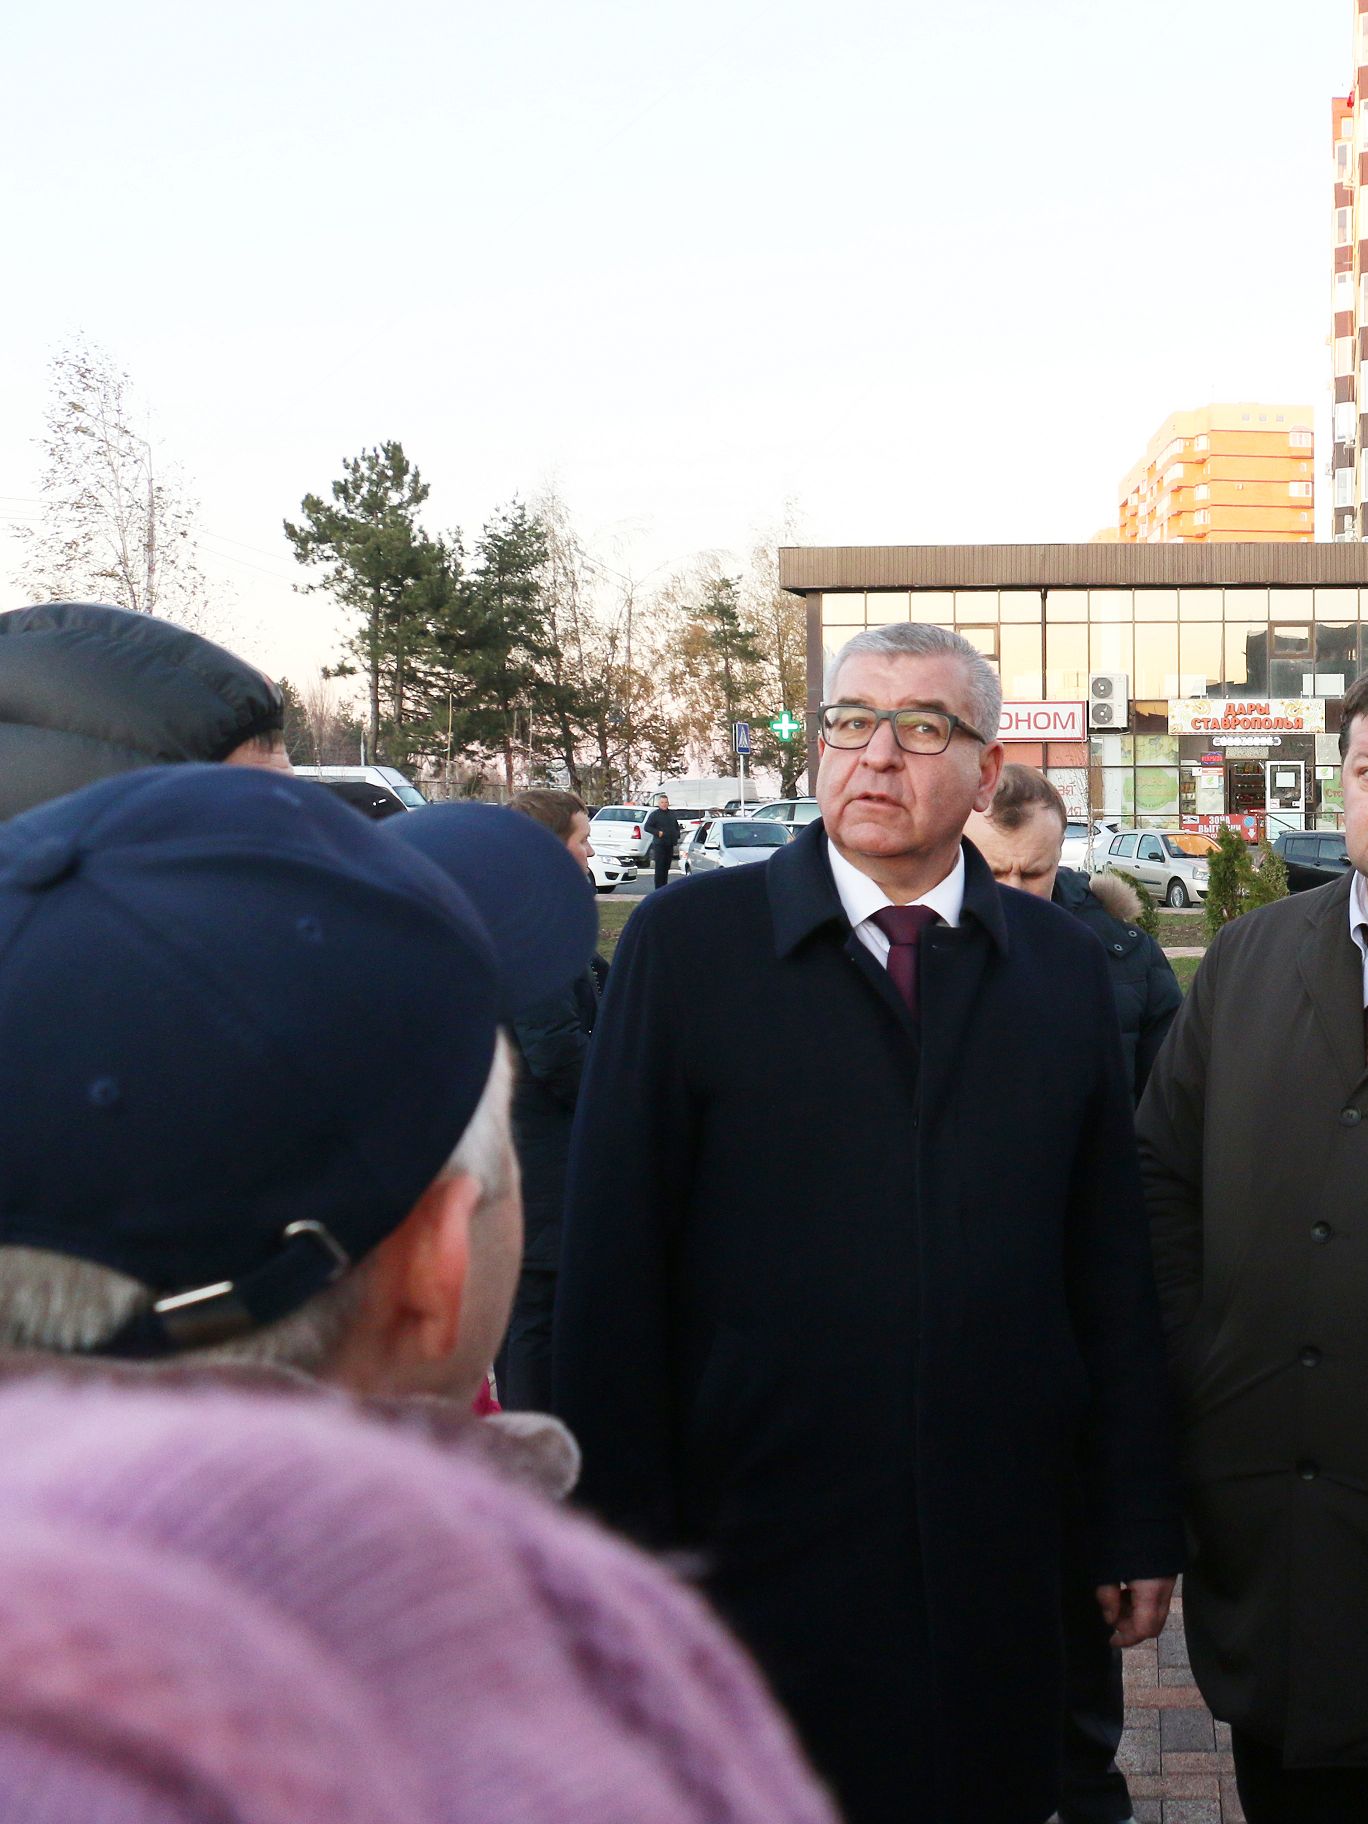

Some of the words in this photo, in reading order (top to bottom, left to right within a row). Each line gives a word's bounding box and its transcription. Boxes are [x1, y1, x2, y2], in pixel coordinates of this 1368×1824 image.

[1224, 703, 1270, 717] ДАРЫ
[1191, 717, 1304, 730] СТАВРОПОЛЬЯ
[1209, 816, 1231, 825] ЗОНА
